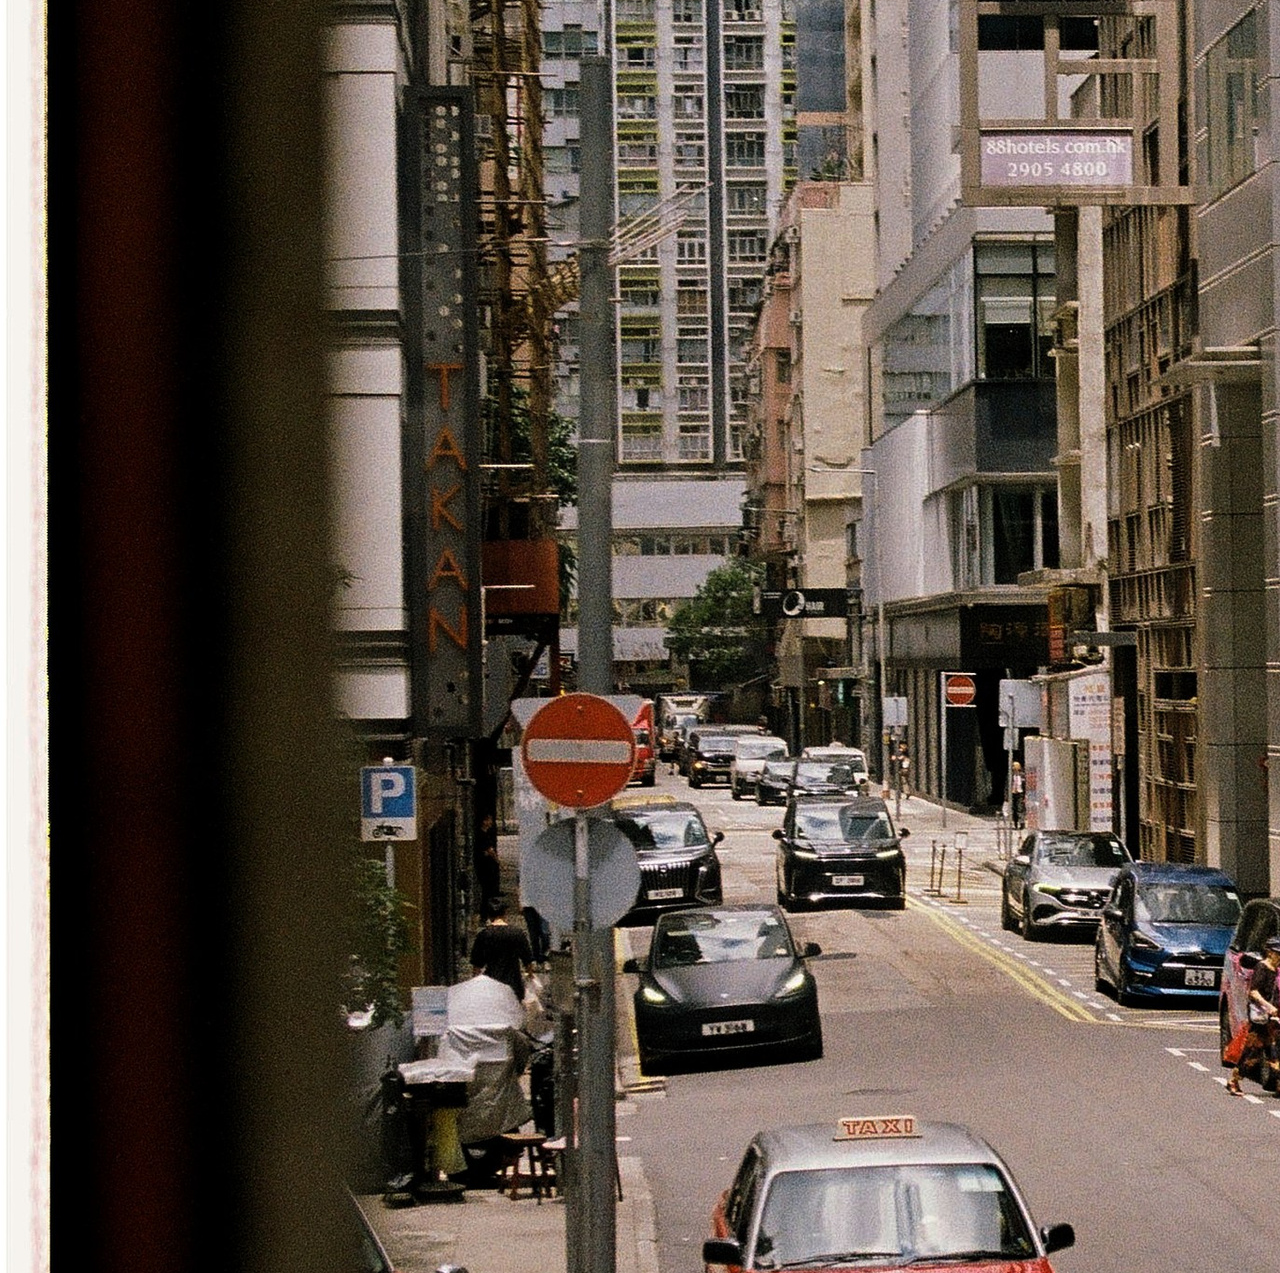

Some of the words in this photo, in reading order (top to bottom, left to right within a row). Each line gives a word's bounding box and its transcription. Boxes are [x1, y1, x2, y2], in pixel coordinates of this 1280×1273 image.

[1008, 162, 1054, 176] 2905
[1060, 161, 1107, 176] 4800
[425, 363, 468, 652] TAKAN
[371, 772, 405, 813] P
[843, 1119, 914, 1135] TAXI
